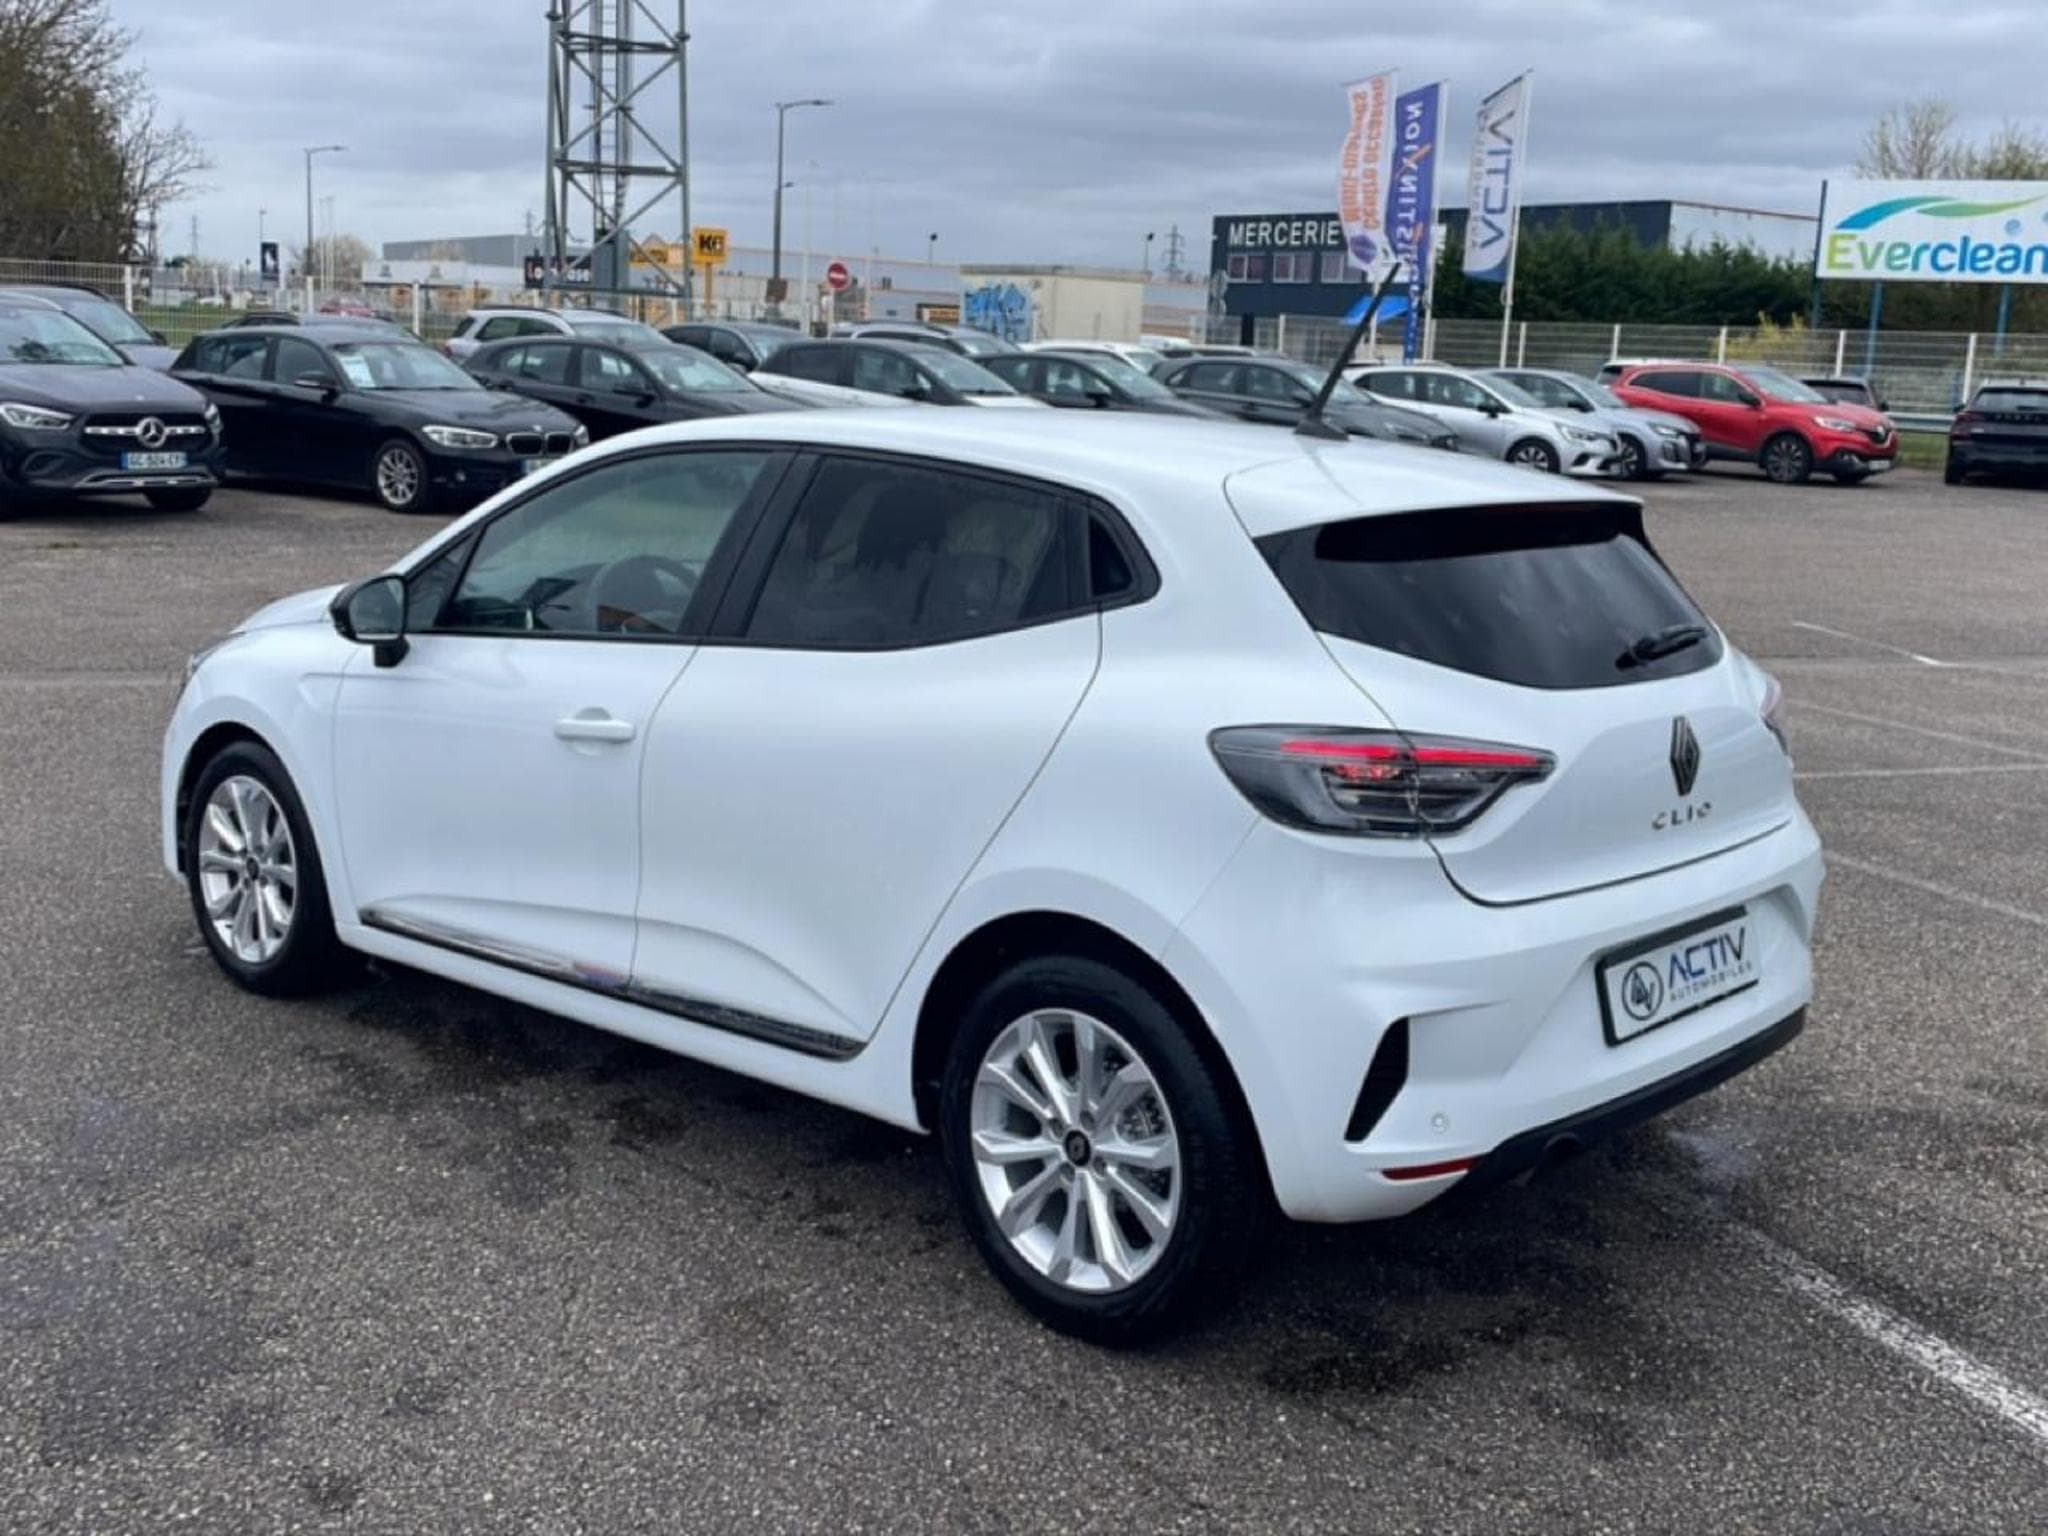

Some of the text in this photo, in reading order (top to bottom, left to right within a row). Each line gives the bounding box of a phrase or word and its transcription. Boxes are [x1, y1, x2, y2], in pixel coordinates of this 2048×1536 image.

[1229, 220, 1340, 246] MERCERIE
[1826, 233, 2048, 274] Everclean
[1651, 801, 1711, 830] CLIO
[1668, 926, 1745, 989] ACTIV
